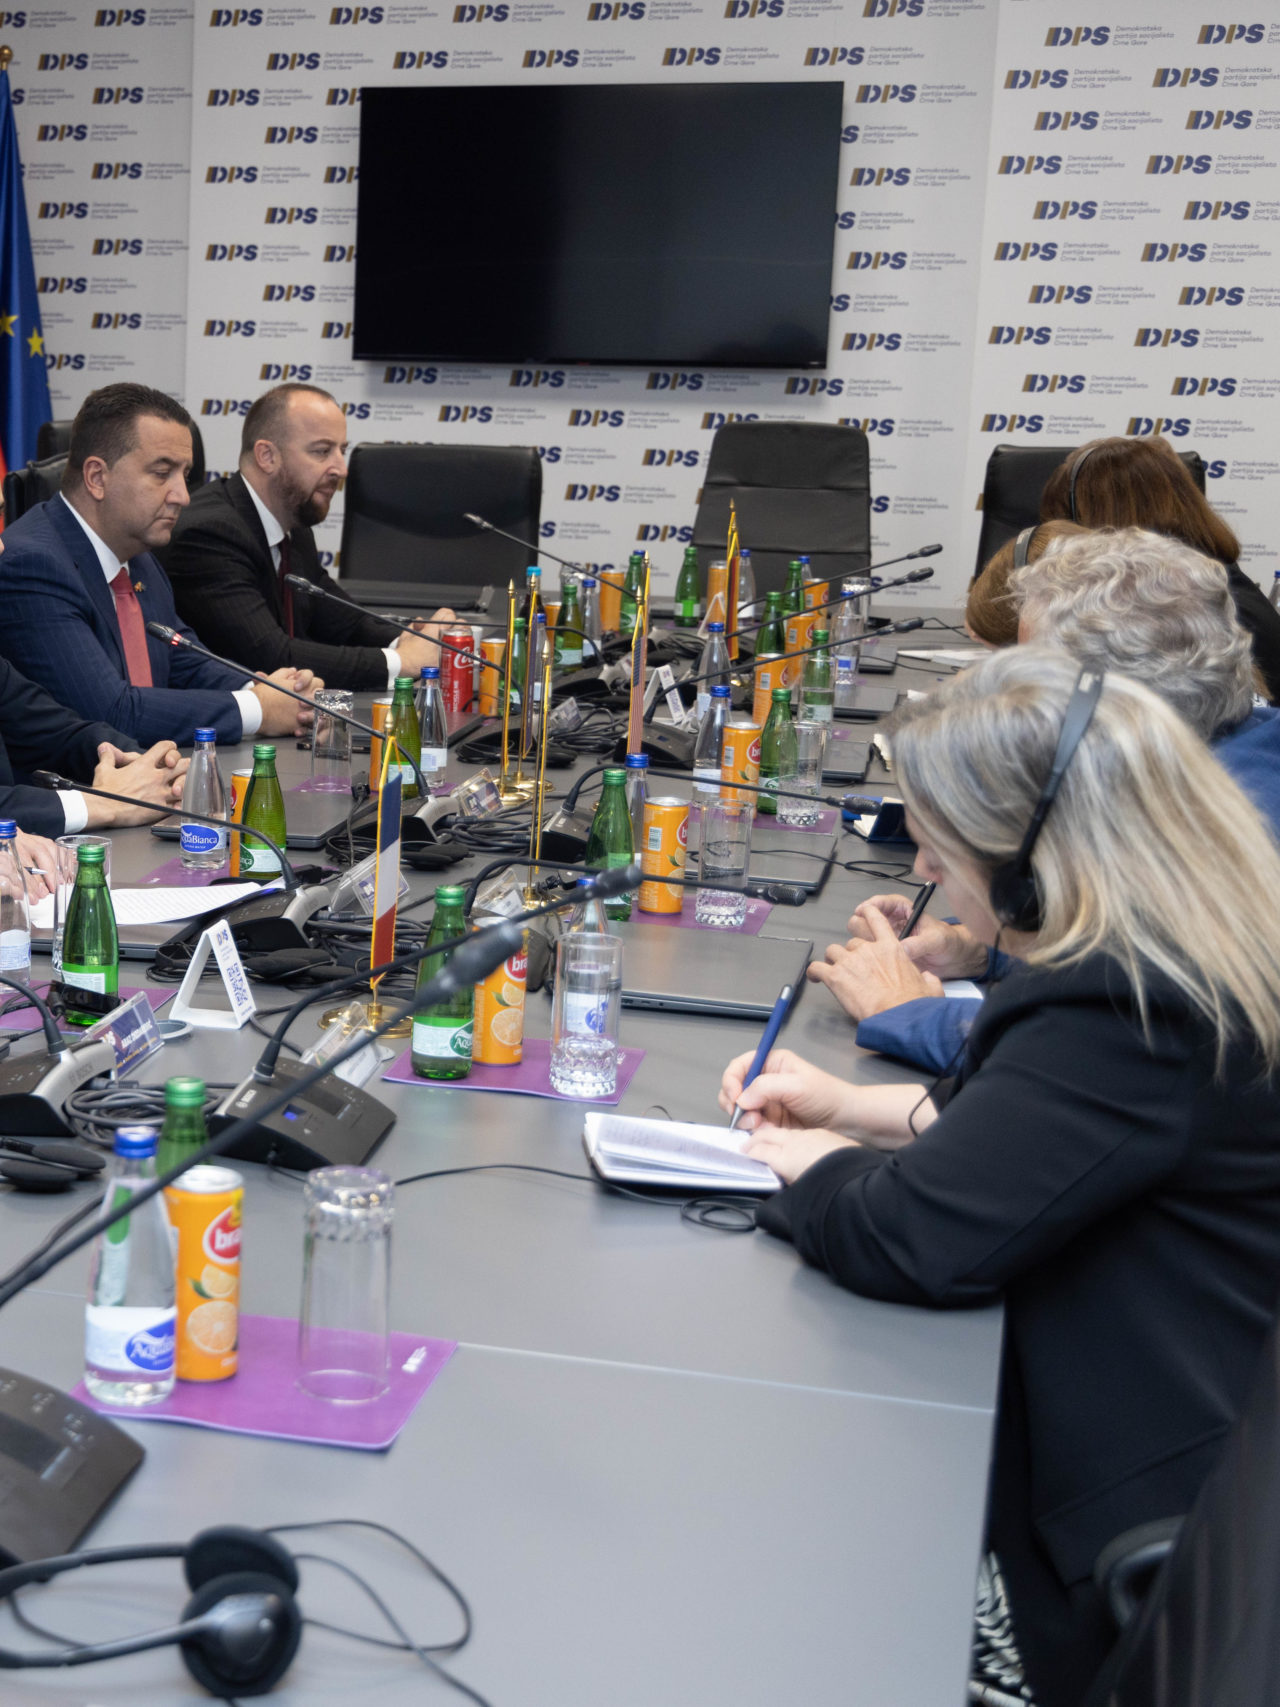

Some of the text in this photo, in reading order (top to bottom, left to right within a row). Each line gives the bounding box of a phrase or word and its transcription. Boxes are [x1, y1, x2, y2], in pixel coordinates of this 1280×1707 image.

[95, 9, 146, 26] DPS
[330, 7, 384, 25] DPS
[453, 4, 509, 22] DPS
[588, 2, 646, 20] DPS
[725, 0, 784, 18] DPS
[863, 0, 924, 17] DPS
[210, 9, 263, 27] DPS
[1045, 27, 1110, 46] DPS
[1198, 24, 1265, 44] DPS
[38, 53, 88, 70] DPS
[267, 53, 320, 70] DPS
[393, 51, 448, 69] DPS
[523, 49, 579, 68] DPS
[663, 47, 721, 65] DPS
[805, 47, 864, 65] DPS
[1005, 70, 1068, 89] DPS
[1153, 68, 1219, 87] DPS
[93, 87, 143, 104] DPS
[207, 89, 260, 106] DPS
[856, 85, 916, 103] DPS
[1035, 111, 1099, 130] DPS
[1186, 110, 1252, 129] DPS
[38, 124, 87, 141] DPS
[265, 127, 318, 143] DPS
[92, 163, 142, 179] DPS
[999, 156, 1062, 174] DPS
[1146, 155, 1212, 174] DPS
[206, 166, 258, 183] DPS
[850, 168, 910, 186] DPS
[38, 202, 88, 219] DPS
[265, 207, 318, 224] DPS
[1034, 201, 1097, 219] DPS
[1184, 201, 1250, 220] DPS
[93, 239, 143, 255] DPS
[206, 244, 258, 261] DPS
[995, 243, 1058, 261] DPS
[1142, 243, 1207, 262] DPS
[847, 252, 907, 269] DPS
[38, 277, 87, 293] DPS
[263, 285, 315, 301] DPS
[1029, 286, 1092, 304] DPS
[1179, 287, 1244, 305] DPS
[92, 313, 141, 329] DPS
[204, 320, 256, 337] DPS
[842, 333, 901, 351] DPS
[989, 327, 1051, 345] DPS
[1135, 328, 1200, 347] DPS
[260, 364, 312, 381] DPS
[384, 366, 439, 384] DPS
[509, 369, 565, 388] DPS
[646, 372, 704, 391] DPS
[784, 376, 844, 396] DPS
[1023, 375, 1085, 393] DPS
[1171, 377, 1237, 396] DPS
[342, 402, 371, 419] PS
[439, 405, 493, 423] DPS
[569, 409, 624, 427] DPS
[981, 414, 1044, 433] DPS
[1126, 417, 1191, 437] DPS
[643, 449, 699, 467] DPS
[565, 484, 620, 502] DPS
